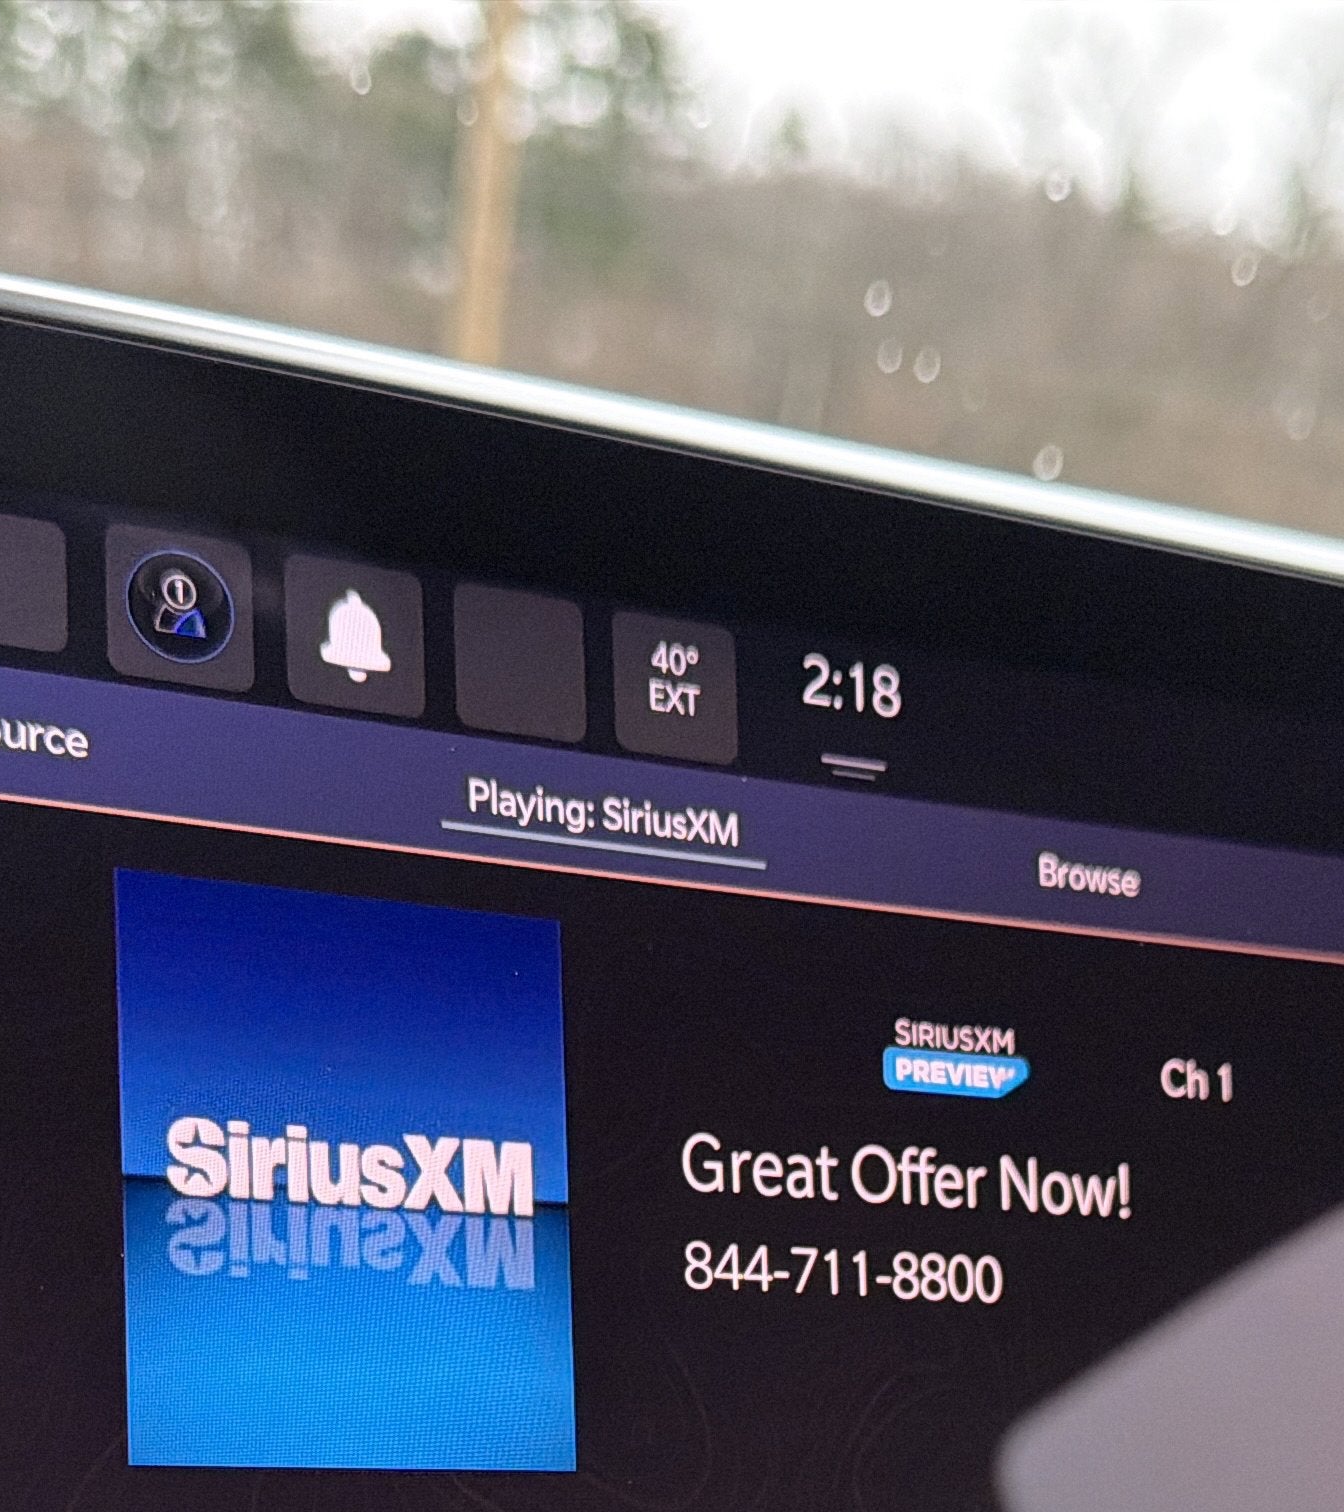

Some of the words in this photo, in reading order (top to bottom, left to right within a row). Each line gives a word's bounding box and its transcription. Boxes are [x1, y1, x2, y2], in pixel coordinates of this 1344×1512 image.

[651, 640, 699, 677] 40°
[649, 679, 700, 717] EXT
[803, 652, 902, 718] 2:18
[468, 777, 595, 831] Playing:
[602, 797, 739, 848] SiriusXM
[1038, 851, 1142, 898] Browse
[895, 1017, 1015, 1055] SIRIUSXM
[896, 1057, 1015, 1089] PREVIEW
[1160, 1058, 1209, 1100] Ch
[1218, 1063, 1233, 1102] 1
[167, 1117, 534, 1216] SiriusXM
[681, 1132, 839, 1200] Great
[851, 1144, 987, 1210] Offer
[1000, 1155, 1132, 1219] Now!
[684, 1240, 1003, 1304] 844-711-8800
